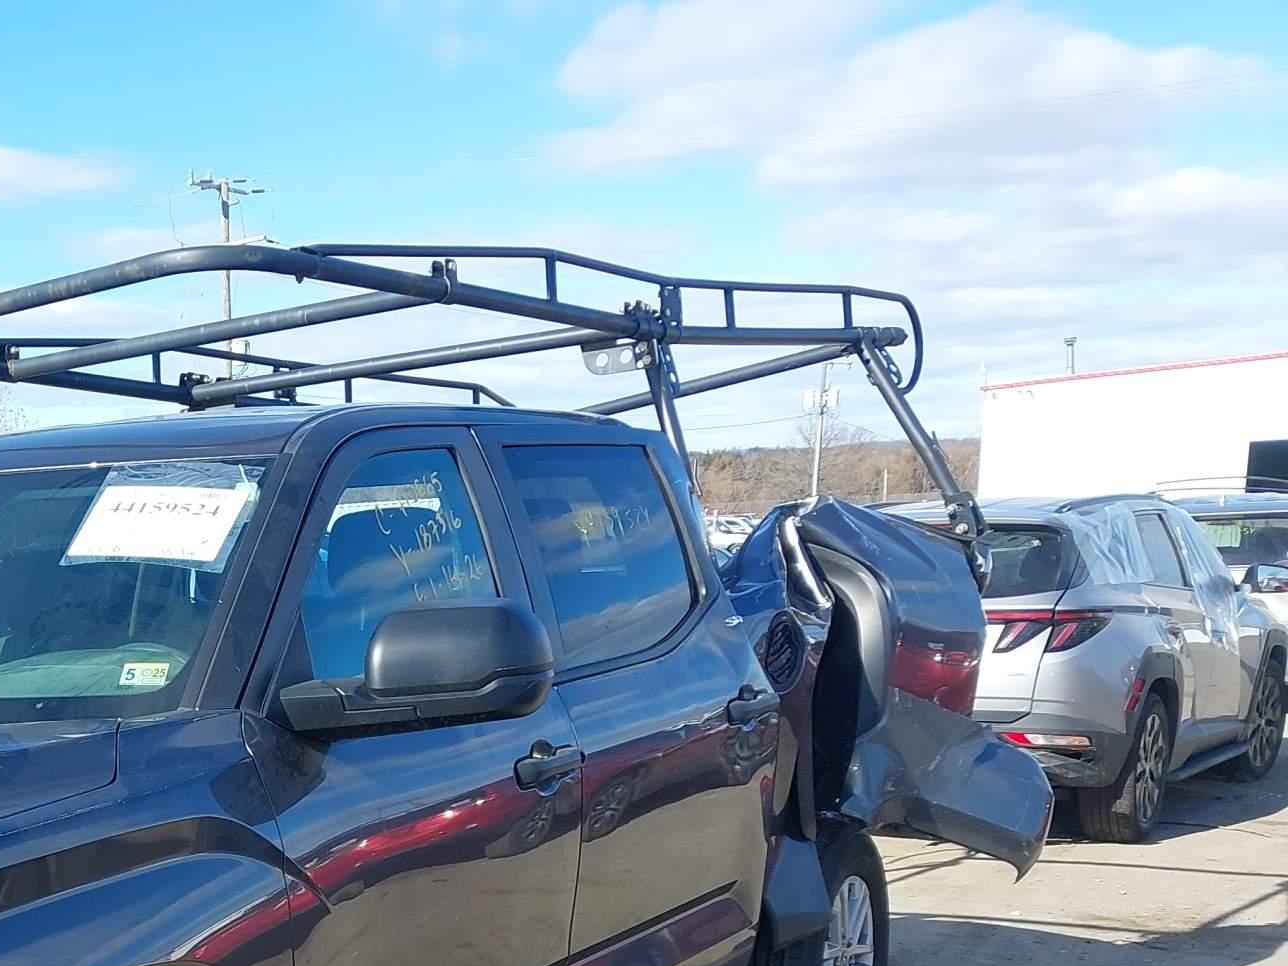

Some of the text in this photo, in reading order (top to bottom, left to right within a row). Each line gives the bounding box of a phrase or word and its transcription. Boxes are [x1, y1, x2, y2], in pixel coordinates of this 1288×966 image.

[105, 500, 221, 518] 44159524
[125, 668, 166, 681] 5 25
